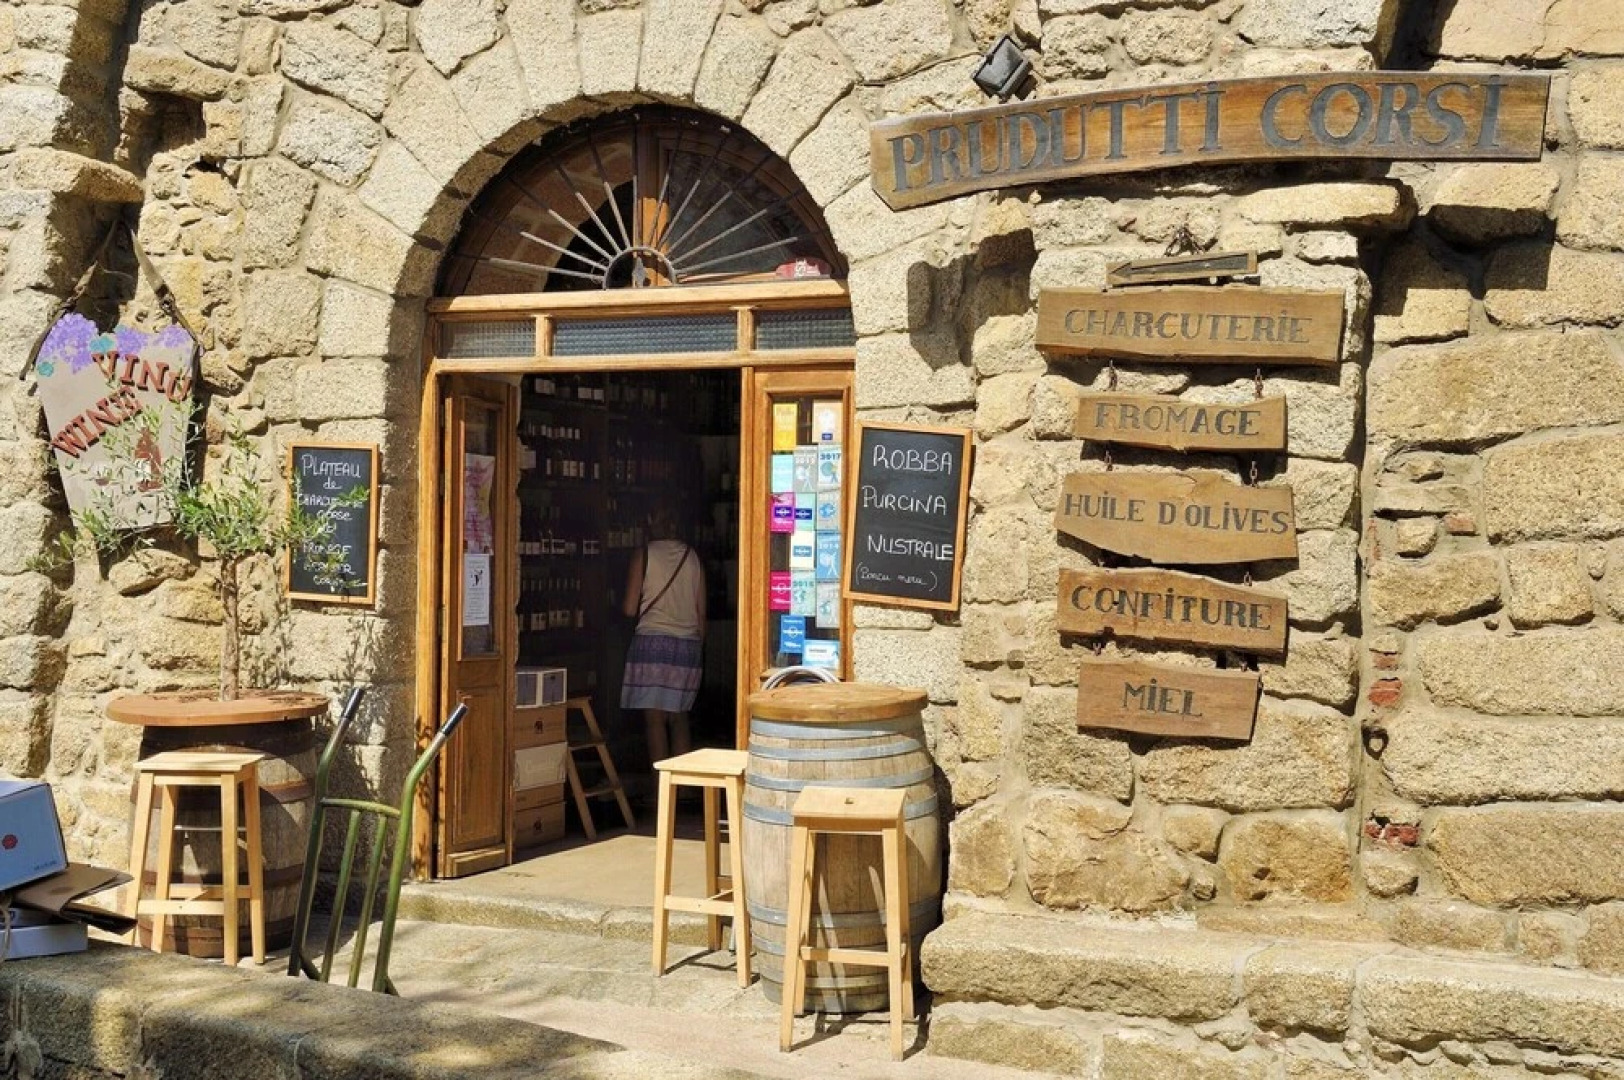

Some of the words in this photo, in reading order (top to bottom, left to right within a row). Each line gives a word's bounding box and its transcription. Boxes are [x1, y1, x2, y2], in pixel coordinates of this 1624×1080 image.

[887, 80, 1227, 194] PRUDUTTI
[1260, 74, 1508, 152] CORSI
[1063, 307, 1313, 345] CHARCUTERIE
[91, 350, 193, 403] VINU
[1093, 401, 1262, 437] FROMAGE
[301, 453, 362, 479] PLATEAU
[872, 443, 953, 476] ROBBA
[861, 485, 948, 516] PURCINA
[1063, 489, 1146, 523] HUILE
[867, 533, 954, 561] NUSTRALE
[1070, 584, 1273, 632] CONFITURE
[1120, 678, 1205, 719] MIEL
